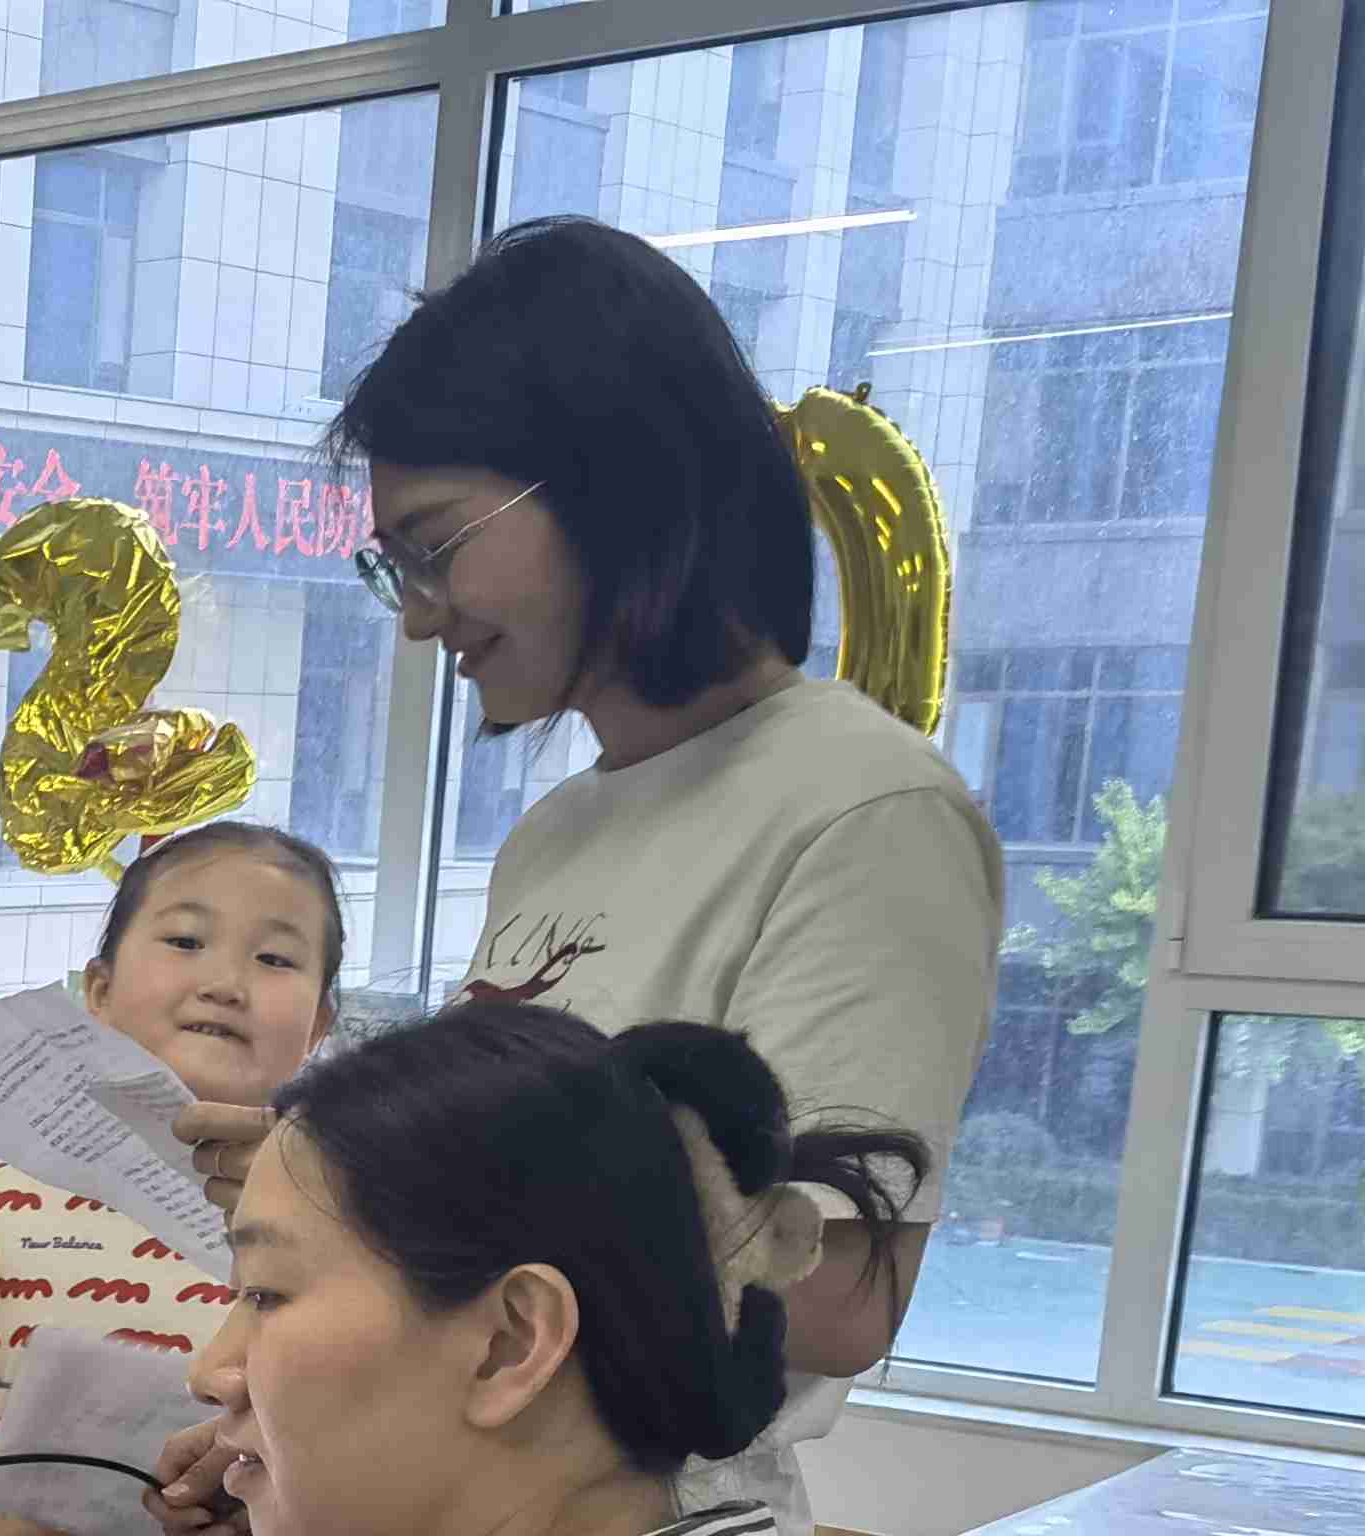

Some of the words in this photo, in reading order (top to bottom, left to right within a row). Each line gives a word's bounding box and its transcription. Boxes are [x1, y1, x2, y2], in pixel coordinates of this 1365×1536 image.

[134, 456, 376, 560] 筑牢人民防
[20, 1236, 49, 1250] New
[53, 1235, 105, 1250] Balance
